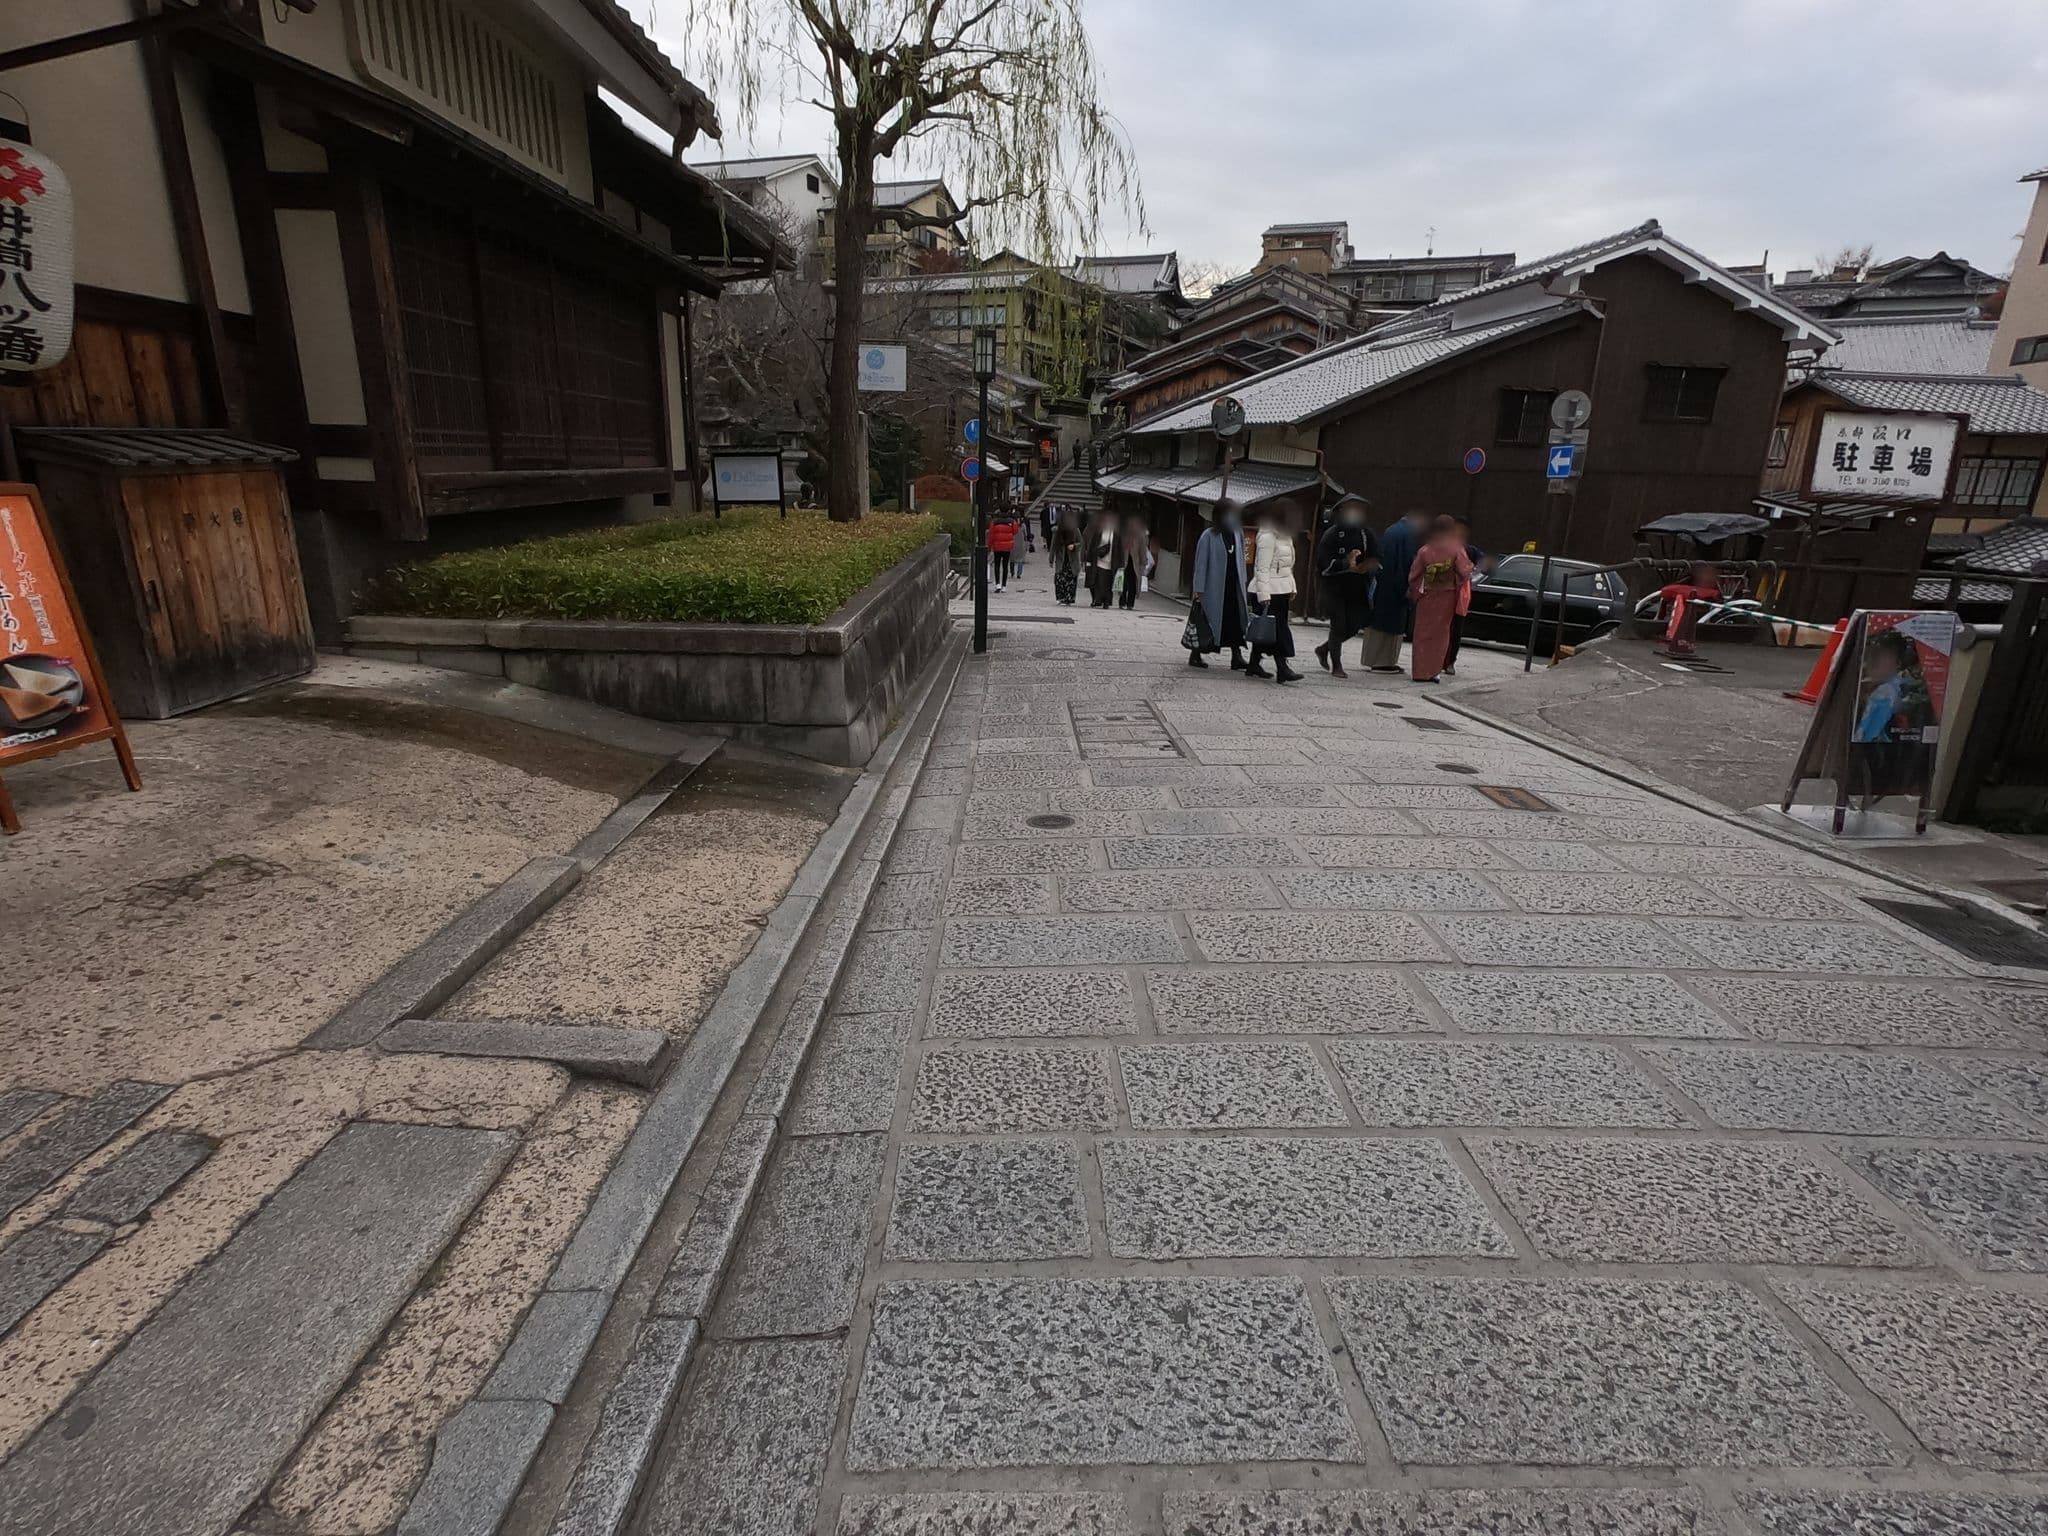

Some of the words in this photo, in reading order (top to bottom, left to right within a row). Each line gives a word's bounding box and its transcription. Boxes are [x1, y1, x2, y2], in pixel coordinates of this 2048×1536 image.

[1832, 442, 1933, 477] 駐車場
[1838, 475, 1852, 485] TEL
